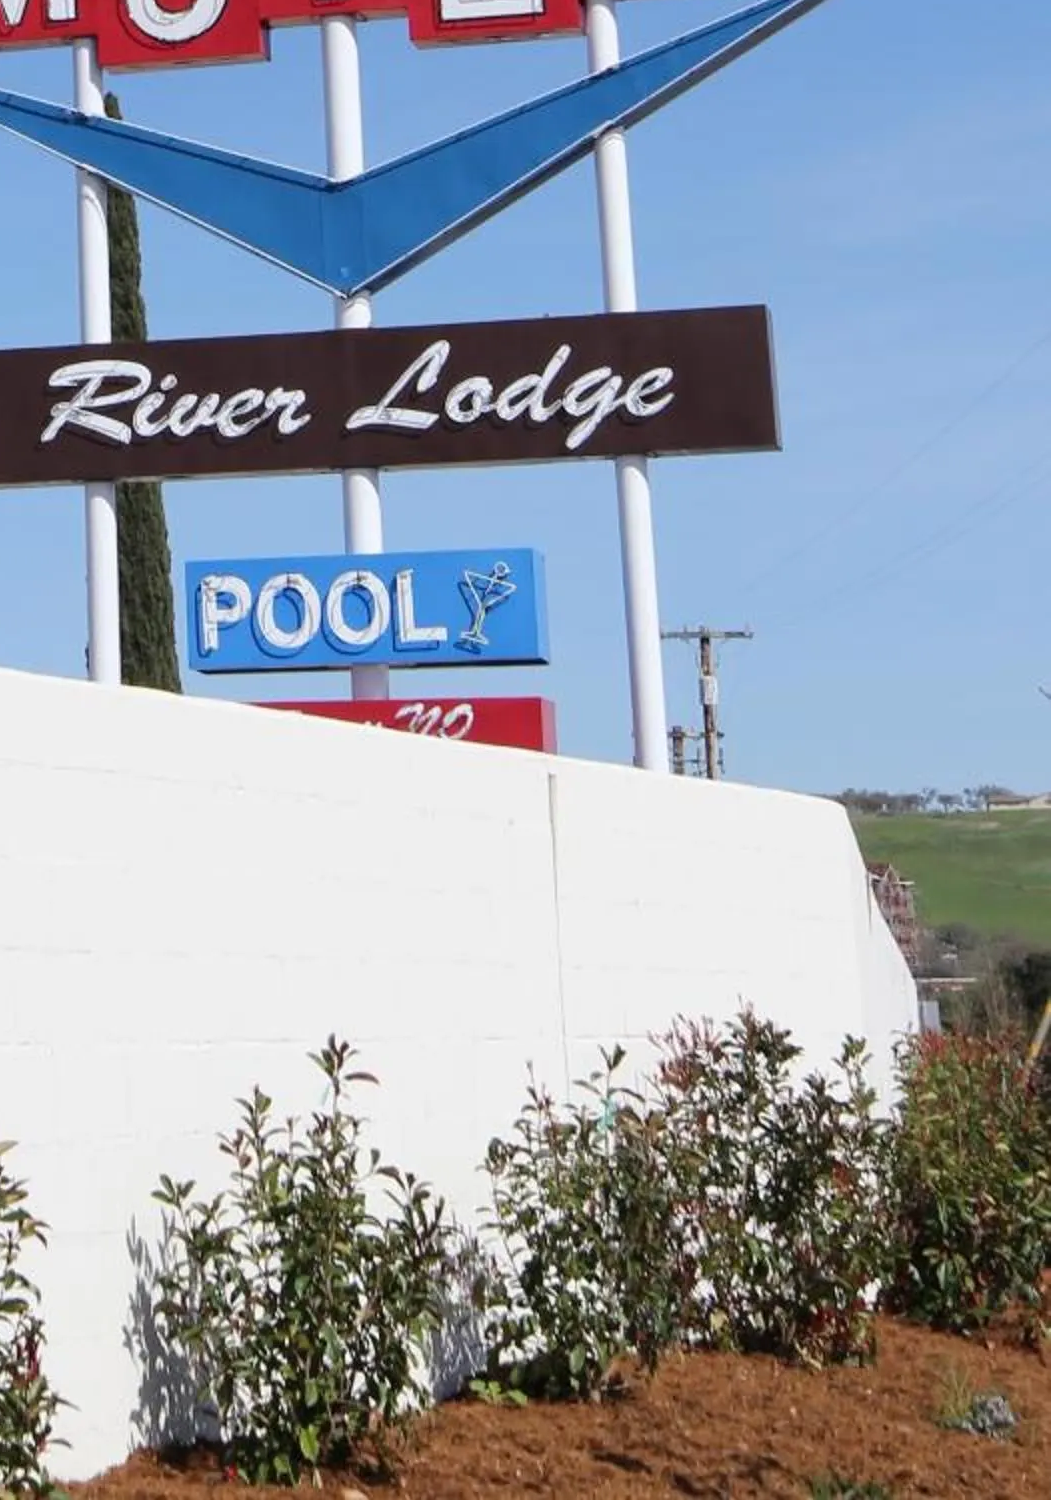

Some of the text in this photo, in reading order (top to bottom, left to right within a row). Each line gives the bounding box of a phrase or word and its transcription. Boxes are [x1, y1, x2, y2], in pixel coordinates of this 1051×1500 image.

[40, 339, 676, 450] River Lodge
[199, 568, 448, 652] POOL
